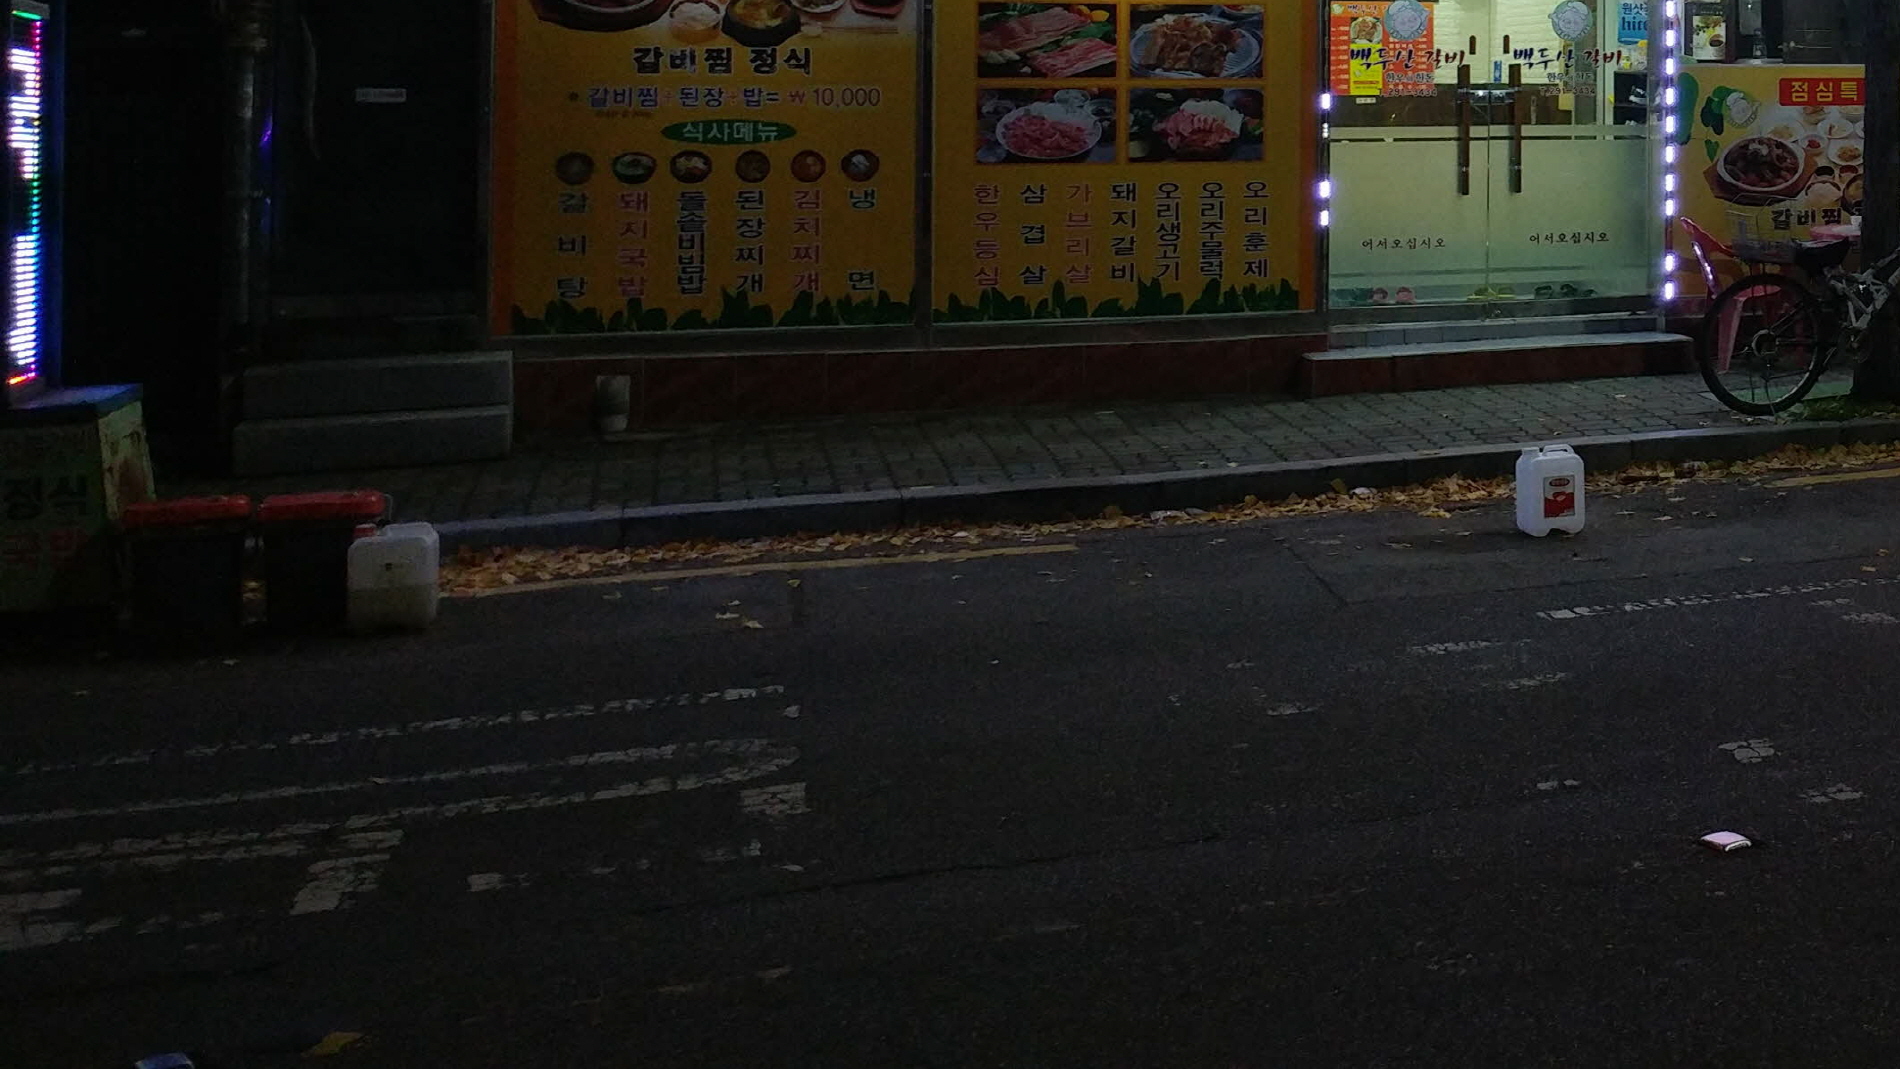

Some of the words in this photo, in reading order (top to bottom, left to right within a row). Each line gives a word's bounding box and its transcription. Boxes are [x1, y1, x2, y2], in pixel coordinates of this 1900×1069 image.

[633, 46, 734, 76] 갈비찜
[749, 47, 813, 76] 정식
[1350, 47, 1415, 71] 백두산
[1424, 48, 1466, 70] 갈비
[1513, 47, 1575, 71] 백두산
[1582, 49, 1622, 69] 갈비
[1790, 80, 1859, 102] 점심특
[682, 122, 780, 142] 식사메뉴
[557, 192, 589, 299] 갈비탕
[617, 192, 650, 297] 돼지국밥
[735, 189, 766, 293] 된장찌개
[793, 189, 823, 292] 김치찌개
[848, 189, 879, 292] 냉면
[973, 183, 1000, 288] 한우등심
[1019, 184, 1048, 285] 삼겹살
[1065, 184, 1093, 284] 가브리살
[1109, 182, 1138, 283] 돼지갈비
[1155, 182, 1183, 282] 오리생고기
[1198, 181, 1225, 281] 오리주물럭
[1242, 181, 1270, 278] 오리훈제
[1361, 237, 1447, 251] 어서오십시오
[1529, 232, 1610, 245] 어서오십시오
